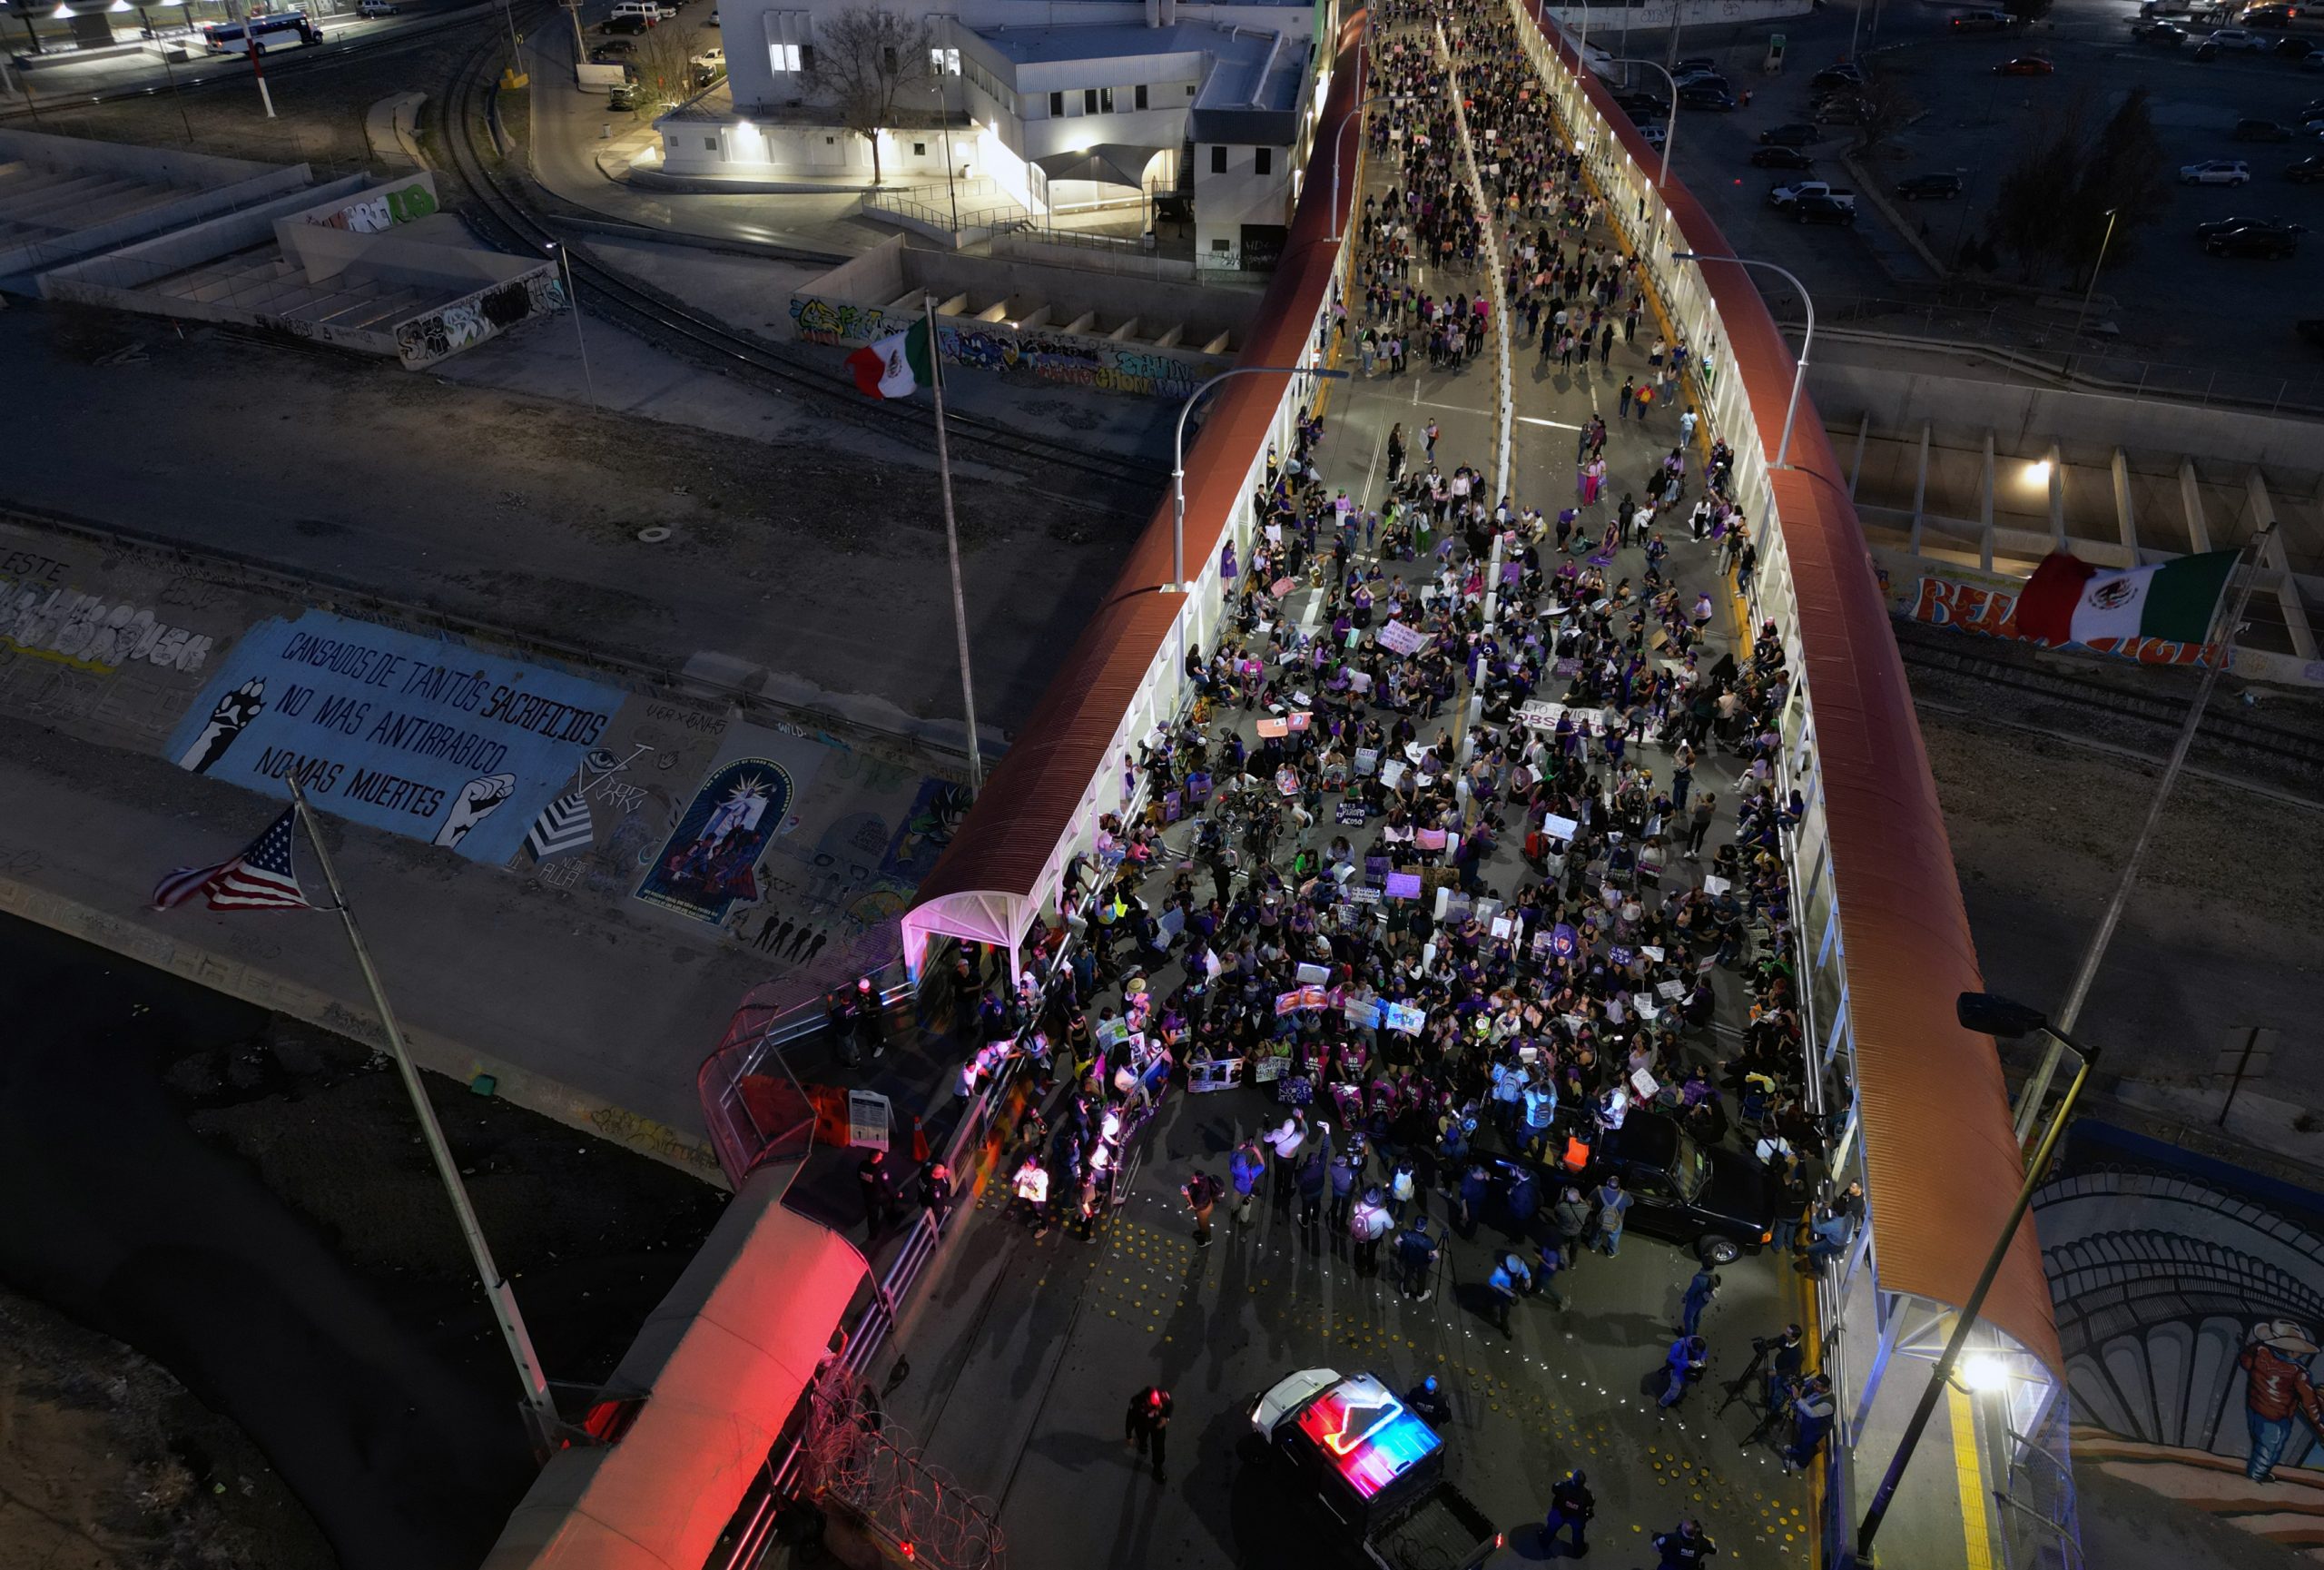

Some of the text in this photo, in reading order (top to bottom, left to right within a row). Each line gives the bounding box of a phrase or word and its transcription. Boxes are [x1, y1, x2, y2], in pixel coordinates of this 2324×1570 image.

[274, 684, 507, 774] NO MAS ANTIRRABICO
[281, 632, 608, 746] CANSADOS DE TANTOS SACRIFICIOS
[253, 746, 446, 818] NO MAS MUERTES
[1297, 1085, 1308, 1095] SE
